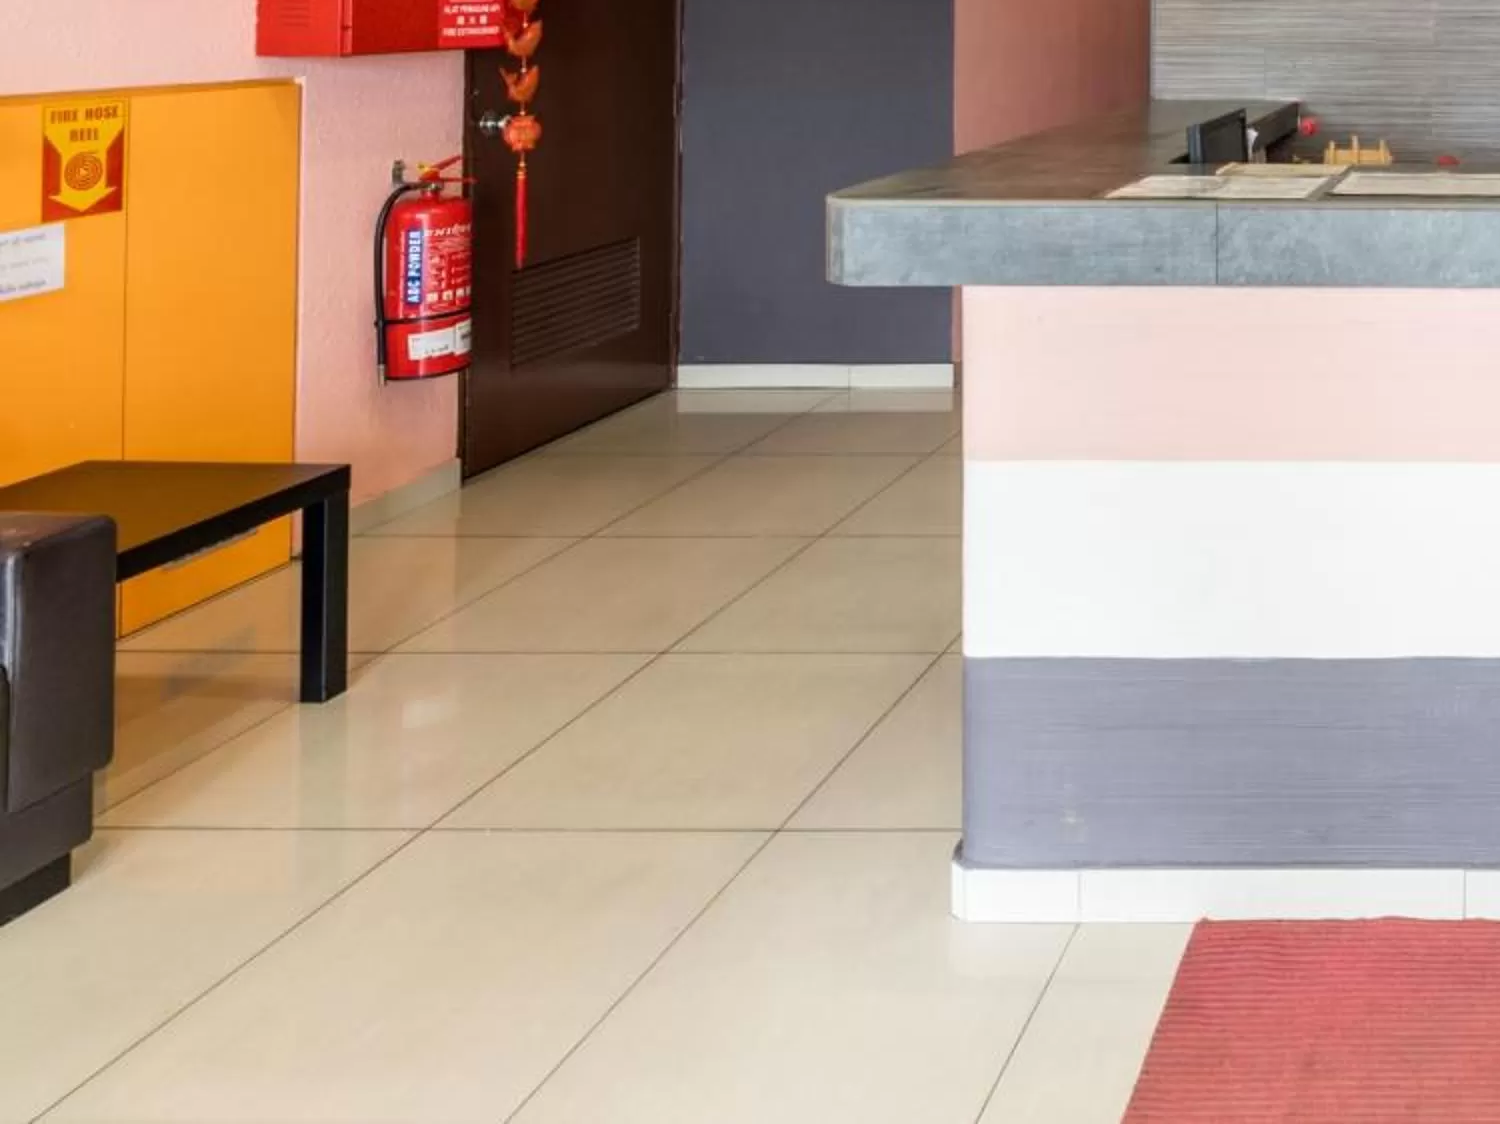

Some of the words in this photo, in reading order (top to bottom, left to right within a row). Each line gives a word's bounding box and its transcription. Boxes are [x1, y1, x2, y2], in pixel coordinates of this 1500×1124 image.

[50, 109, 78, 125] FIRE
[85, 104, 118, 121] HOSE
[69, 127, 98, 142] REEL
[407, 230, 421, 278] POWDER
[407, 280, 420, 303] ABC
